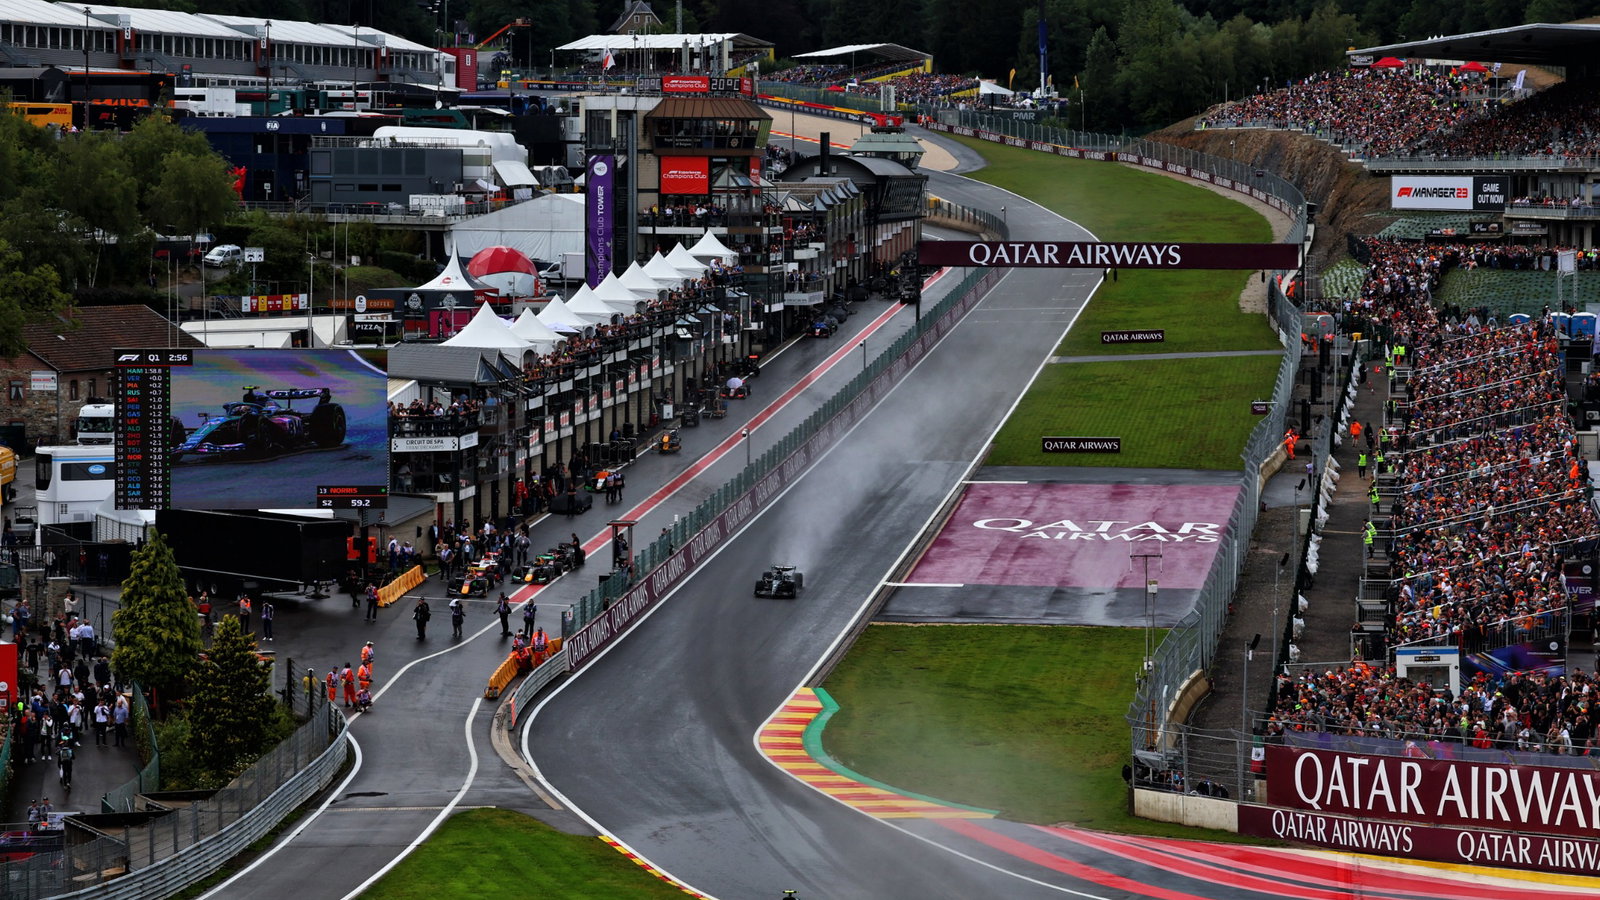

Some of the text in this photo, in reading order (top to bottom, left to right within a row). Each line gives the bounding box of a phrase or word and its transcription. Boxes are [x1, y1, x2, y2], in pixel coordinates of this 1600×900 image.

[1013, 112, 1035, 120] PMR
[266, 122, 278, 130] FIA
[1412, 188, 1456, 198] MANAGER
[1456, 188, 1468, 198] 23
[1482, 184, 1499, 192] GAME
[1478, 194, 1504, 204] OUT NOW
[969, 243, 1182, 266] QATAR AIRWAYS
[1103, 332, 1162, 342] QATAR AIRWAYS
[148, 354, 159, 362] Q1
[1044, 441, 1118, 450] QATAR AIRWAYS
[973, 518, 1220, 534] QATAR
[690, 521, 720, 564] QATAR AIRWAYS
[1019, 531, 1218, 542] AIRWAYS
[652, 550, 686, 598] QATAR AIRWAYS
[612, 583, 648, 632] QATAR AIRWAYS
[569, 614, 610, 667] QATAR AIRWAYS
[1294, 752, 1426, 815] QATAR
[1272, 810, 1412, 852] QATAR AIRWAYS
[1456, 831, 1532, 864] QATAR
